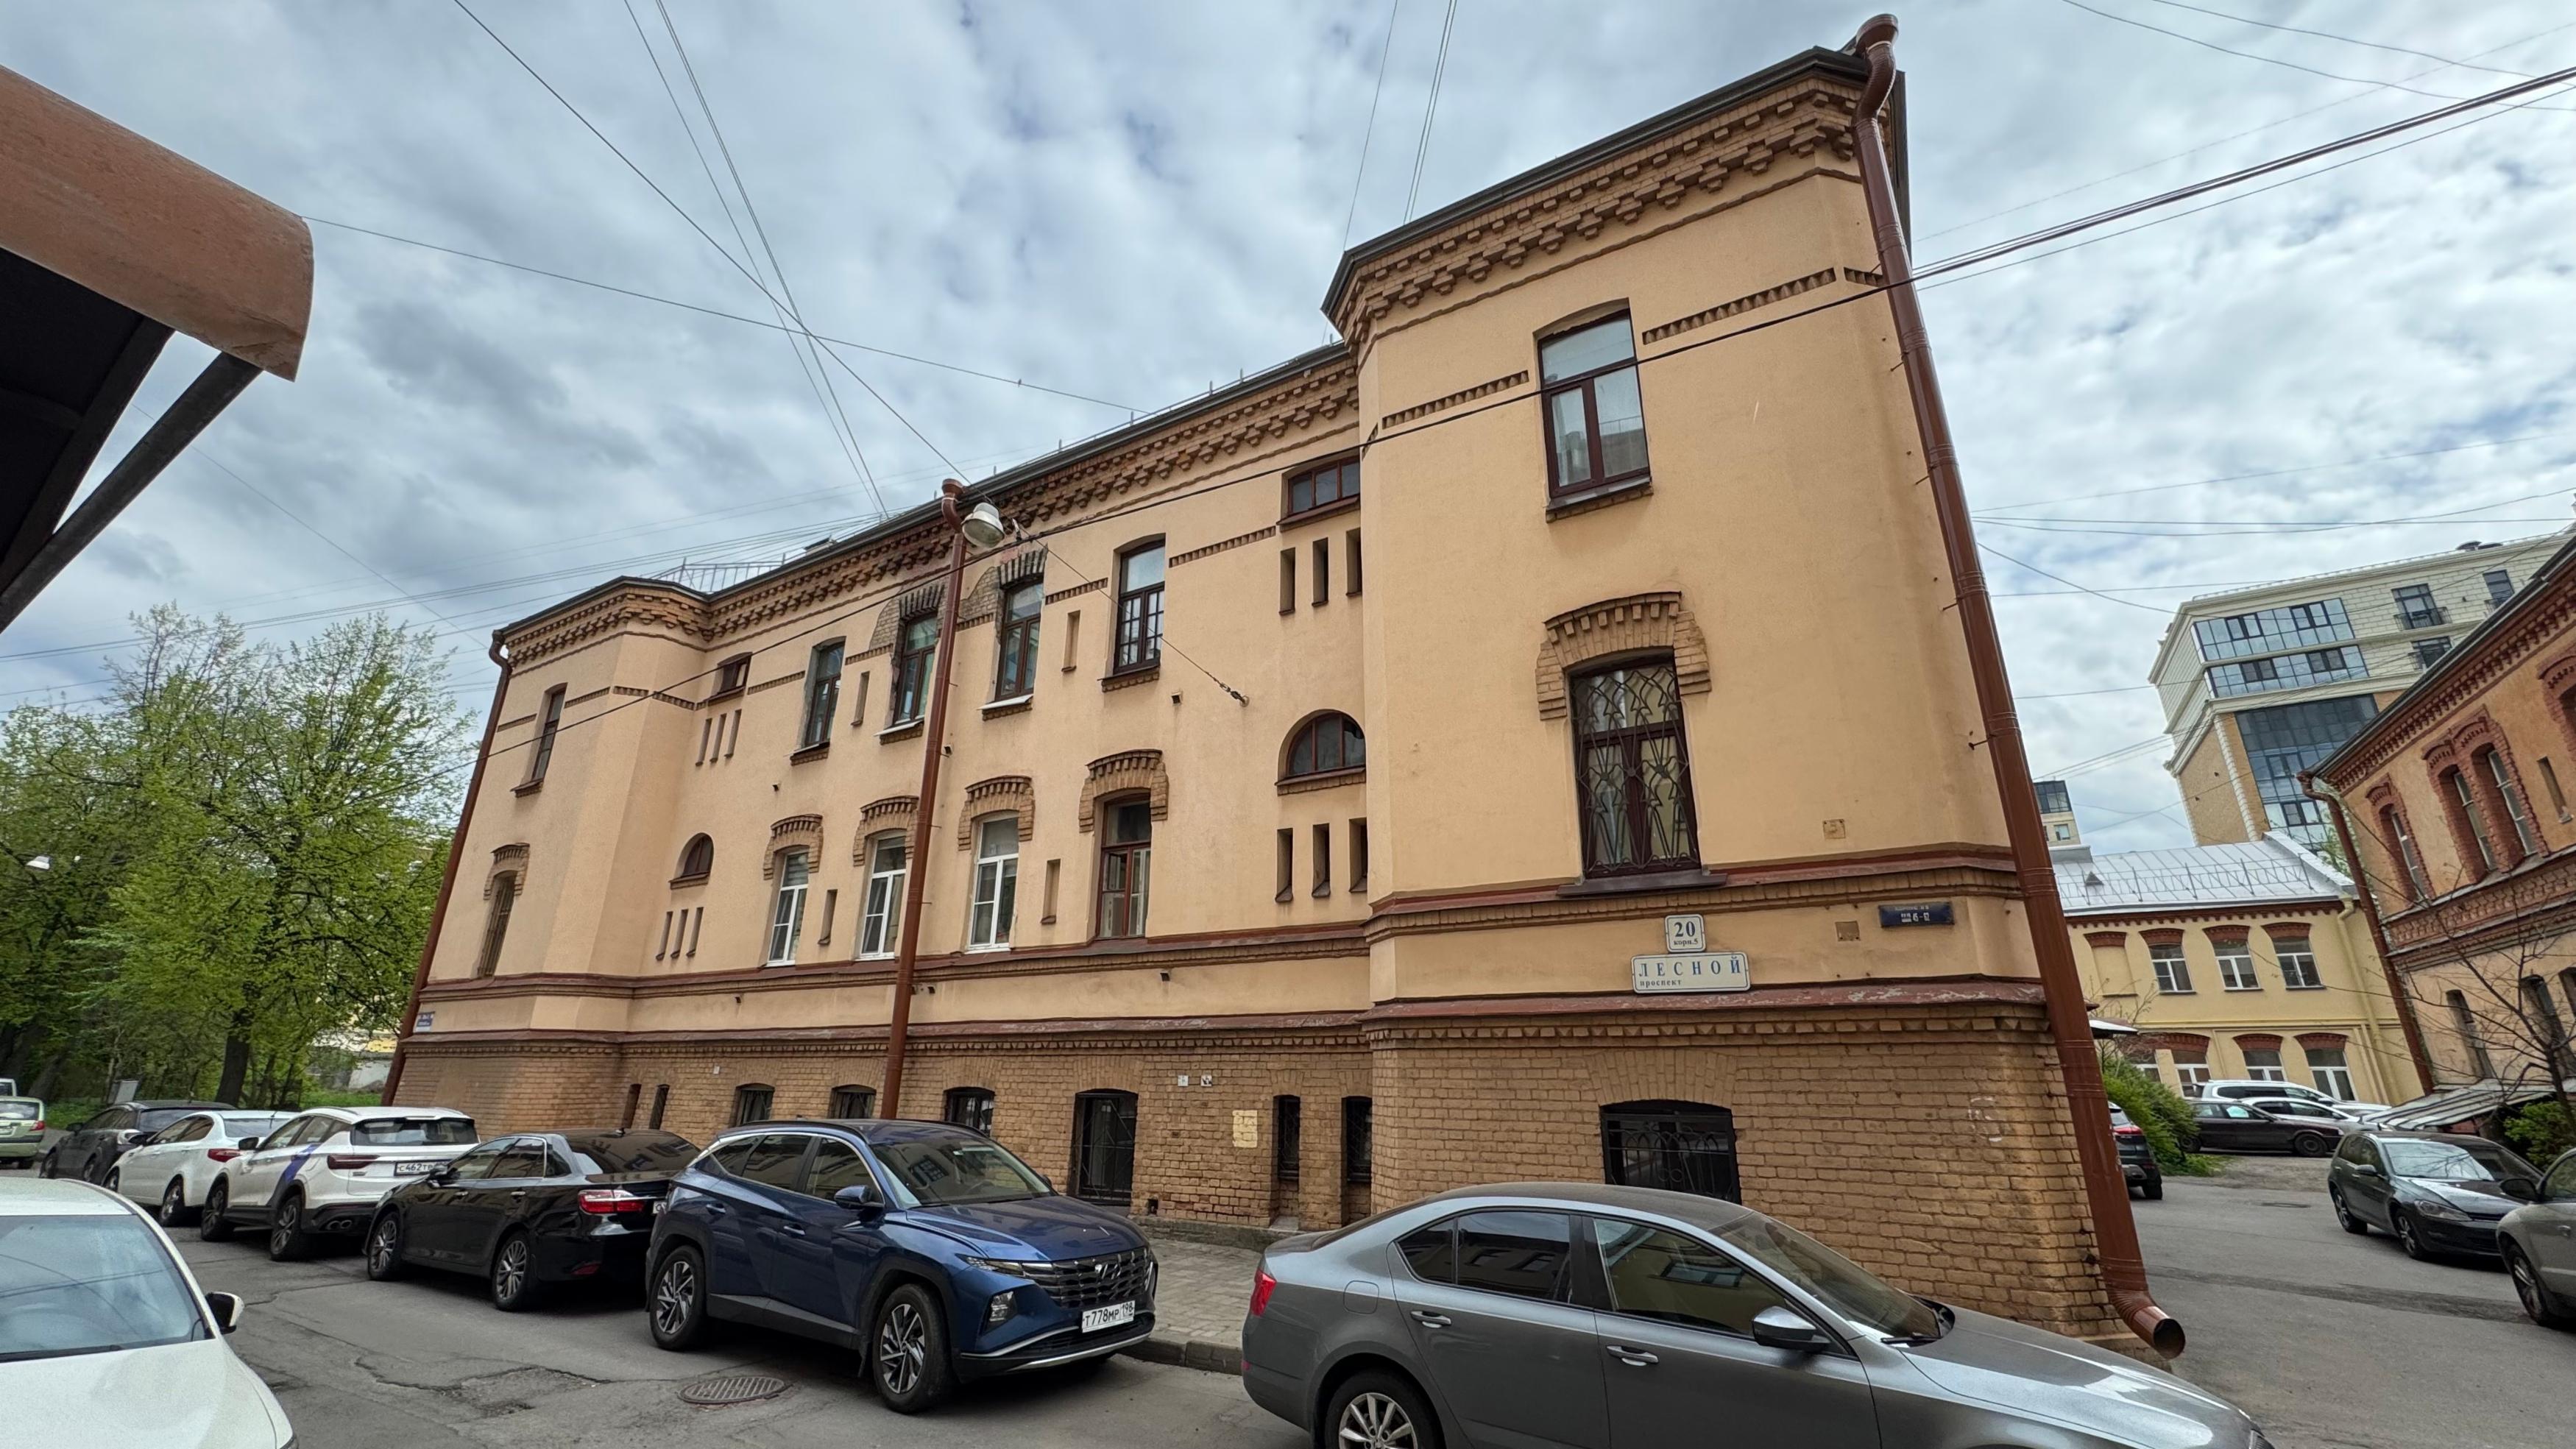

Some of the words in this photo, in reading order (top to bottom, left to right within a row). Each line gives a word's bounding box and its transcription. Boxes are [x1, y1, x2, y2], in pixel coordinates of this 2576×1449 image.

[1674, 921, 1696, 938] 20
[1674, 938, 1699, 947] корп.5
[1638, 956, 1741, 977] ЛЕСНОЙ
[1639, 979, 1682, 988] проспект
